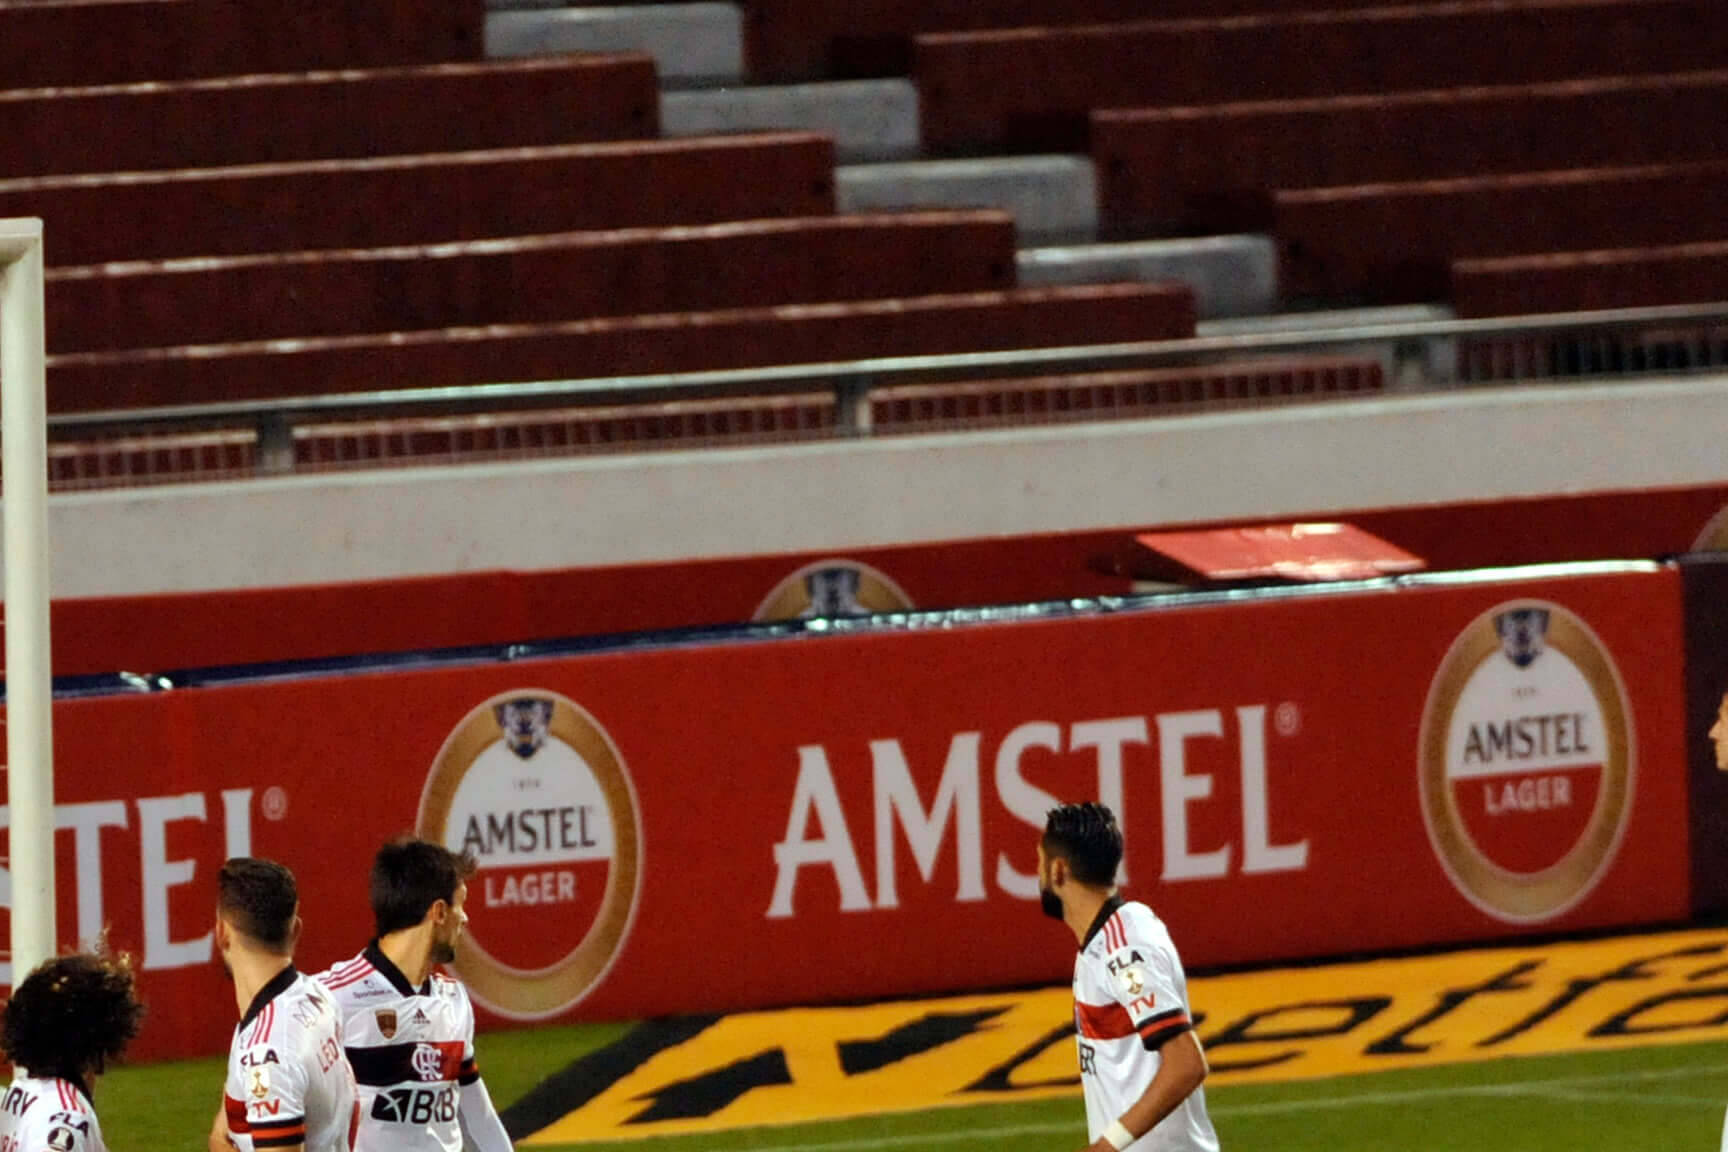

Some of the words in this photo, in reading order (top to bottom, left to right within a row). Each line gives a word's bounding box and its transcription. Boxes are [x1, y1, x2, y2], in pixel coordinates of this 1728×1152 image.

[1464, 713, 1589, 764] AMSTEL
[764, 706, 1308, 918] AMSTEL
[1484, 775, 1571, 816] LAGER
[462, 805, 597, 855] AMSTEL
[485, 871, 575, 907] LAGER
[1108, 950, 1145, 977] FLA
[1130, 993, 1156, 1015] TV
[252, 1098, 280, 1117] TV
